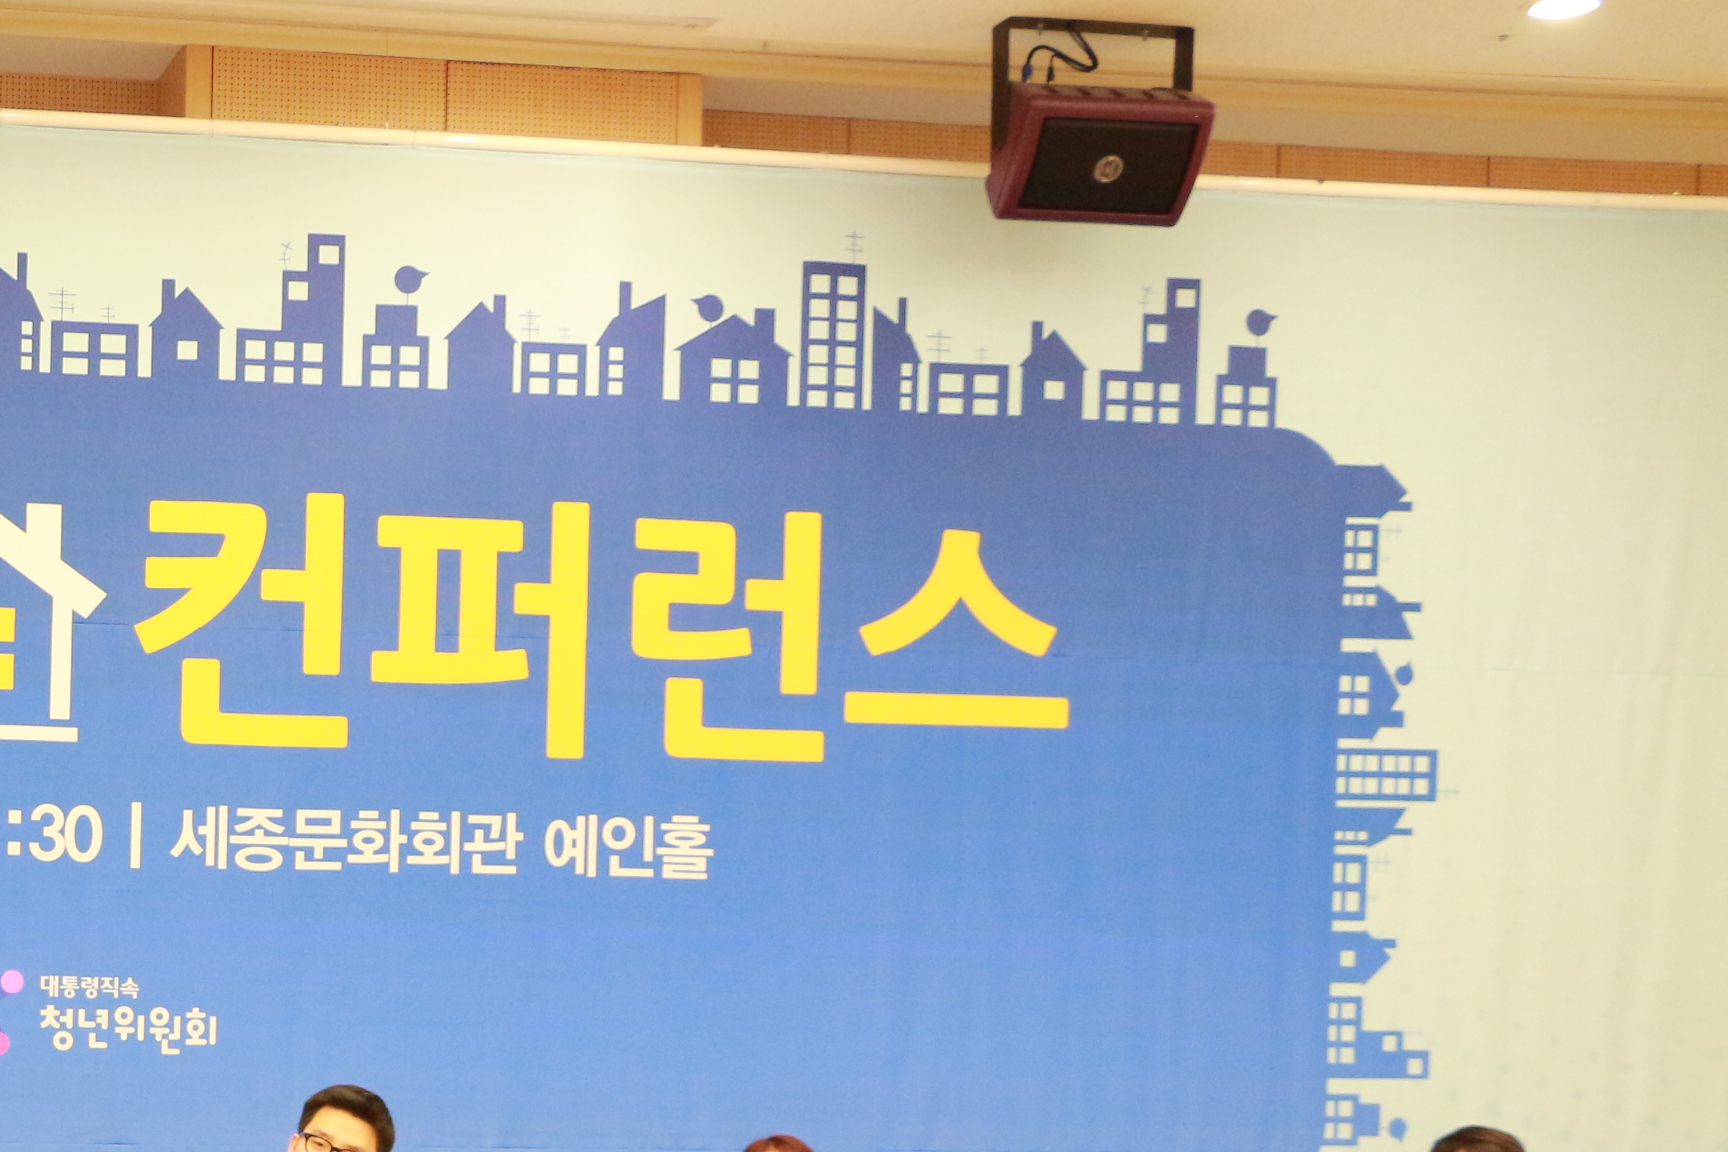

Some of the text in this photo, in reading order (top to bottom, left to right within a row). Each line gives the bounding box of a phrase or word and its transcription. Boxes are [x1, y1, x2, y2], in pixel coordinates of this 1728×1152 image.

[133, 491, 1070, 763] 컨퍼런스
[169, 804, 524, 876] 세종문화회관
[543, 813, 715, 881] 예인홀
[39, 974, 141, 1000] 대통령직속
[39, 1004, 218, 1056] 청년위원회
